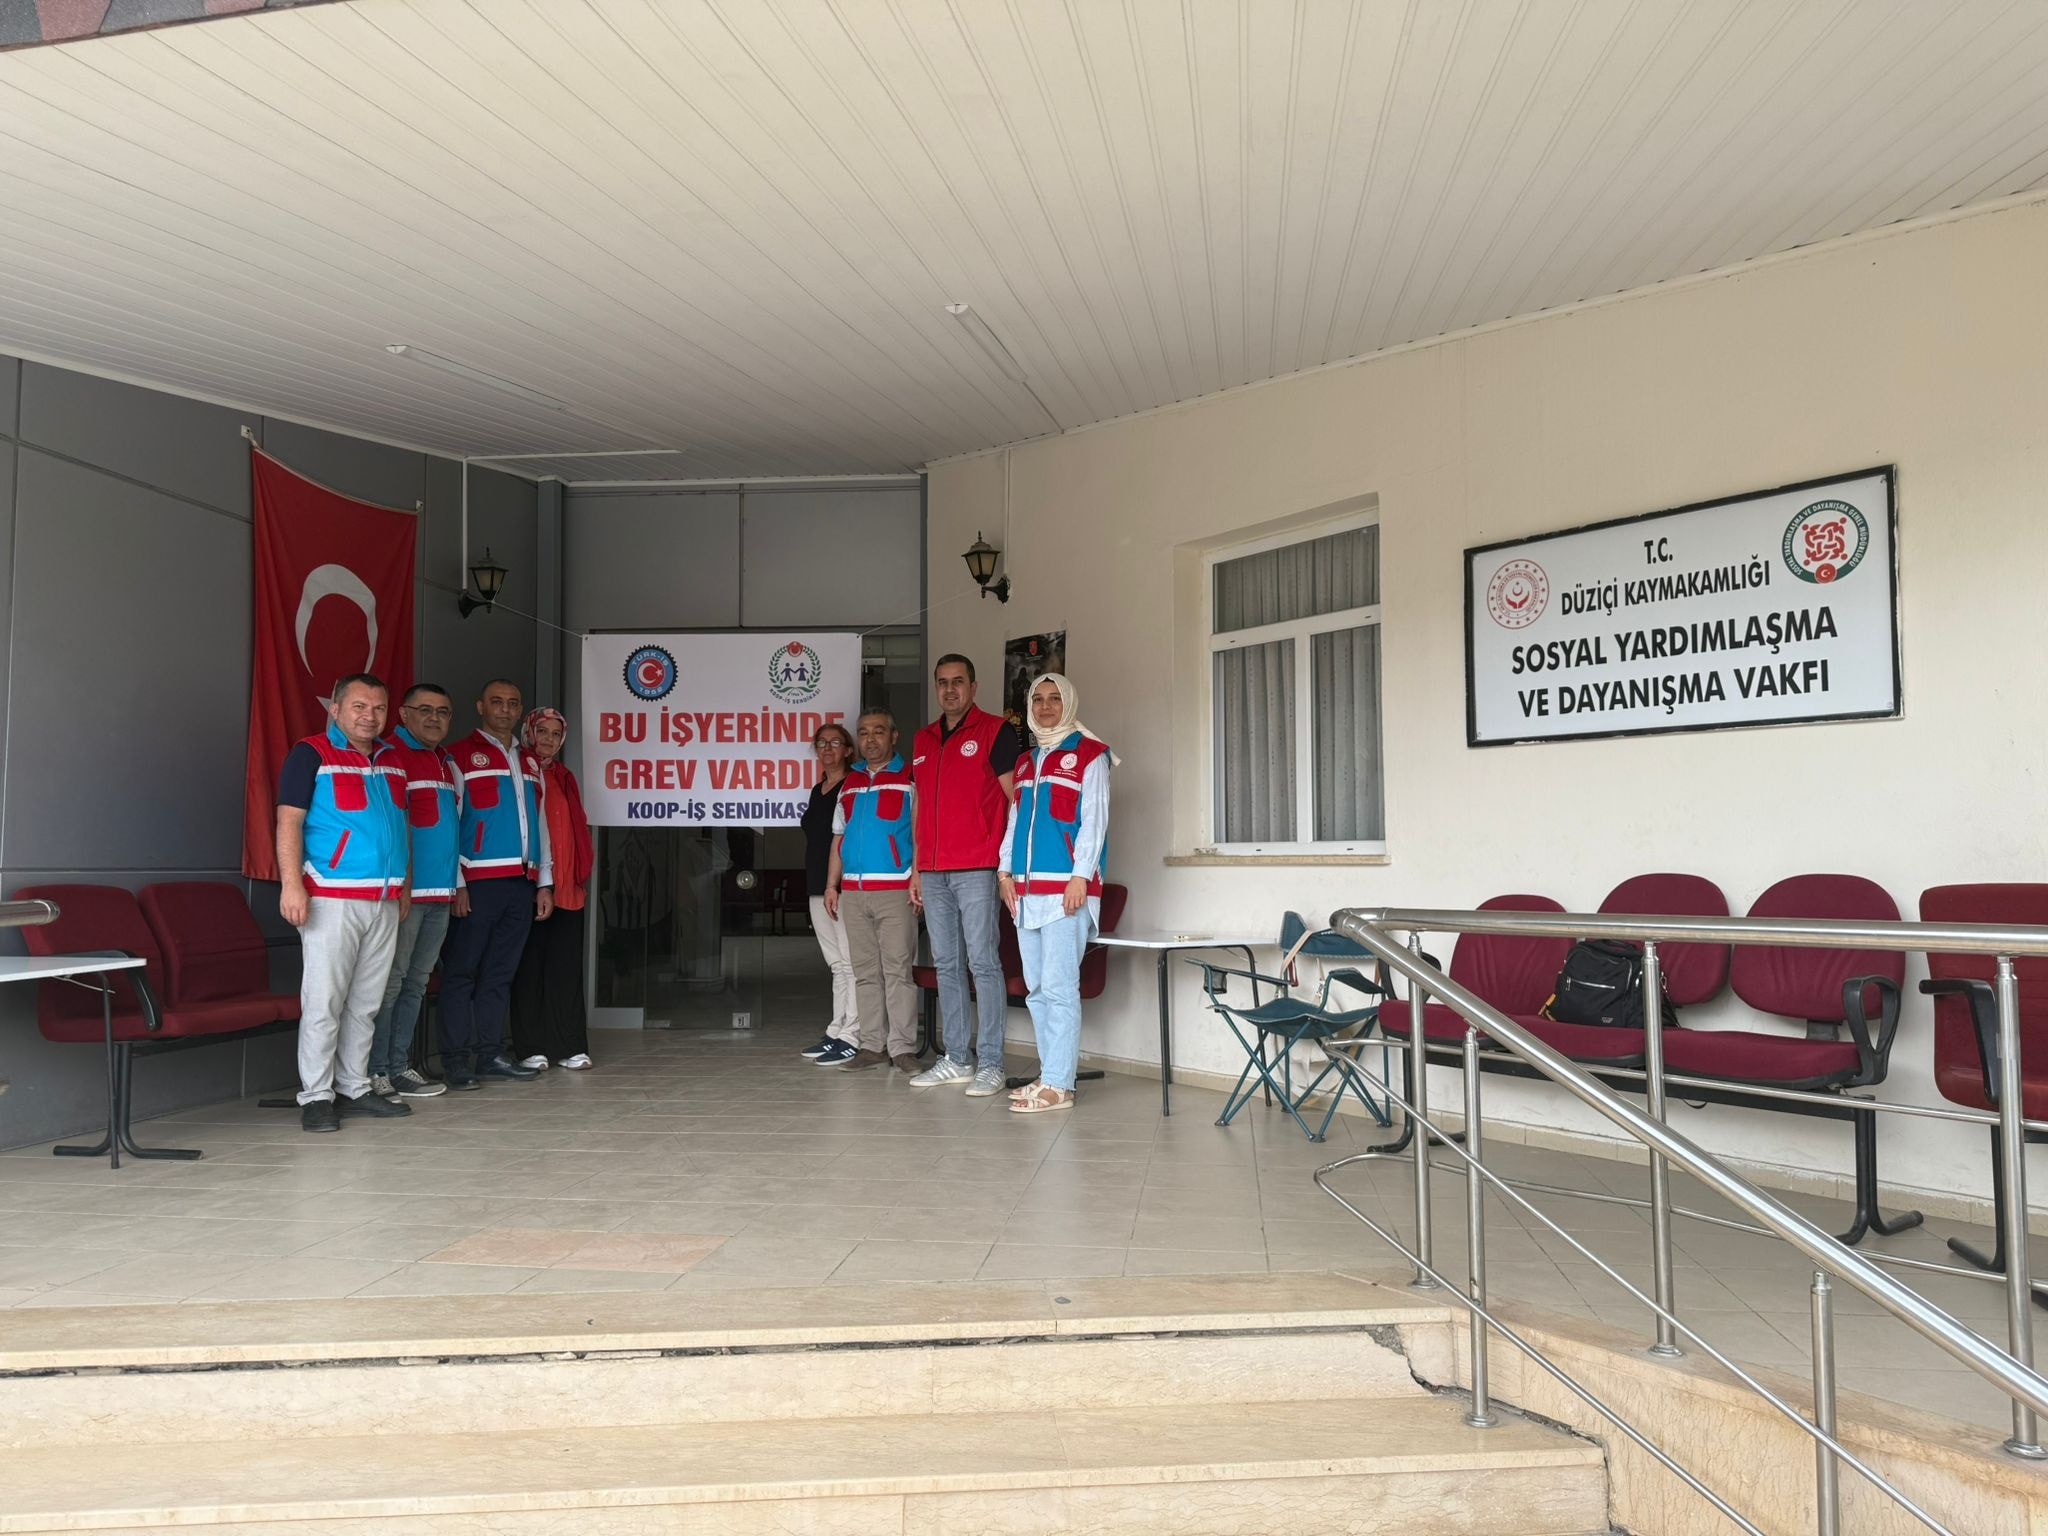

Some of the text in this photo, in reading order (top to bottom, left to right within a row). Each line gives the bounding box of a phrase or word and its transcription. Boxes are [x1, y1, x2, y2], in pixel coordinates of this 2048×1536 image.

[1644, 537, 1673, 564] T.C.
[1561, 577, 1618, 616] DÜZİÇİ
[1625, 553, 1770, 606] KAYMAKAMLIĞI
[1512, 606, 1838, 674] SOSYAL YARDIMLAŞMA
[1518, 659, 1829, 717] VE DAYANIŞMA VAKFI
[600, 712, 647, 743] BU
[604, 759, 822, 790] GREV VARDI
[628, 799, 808, 821] KOOP-İŞ SENDİKAS
